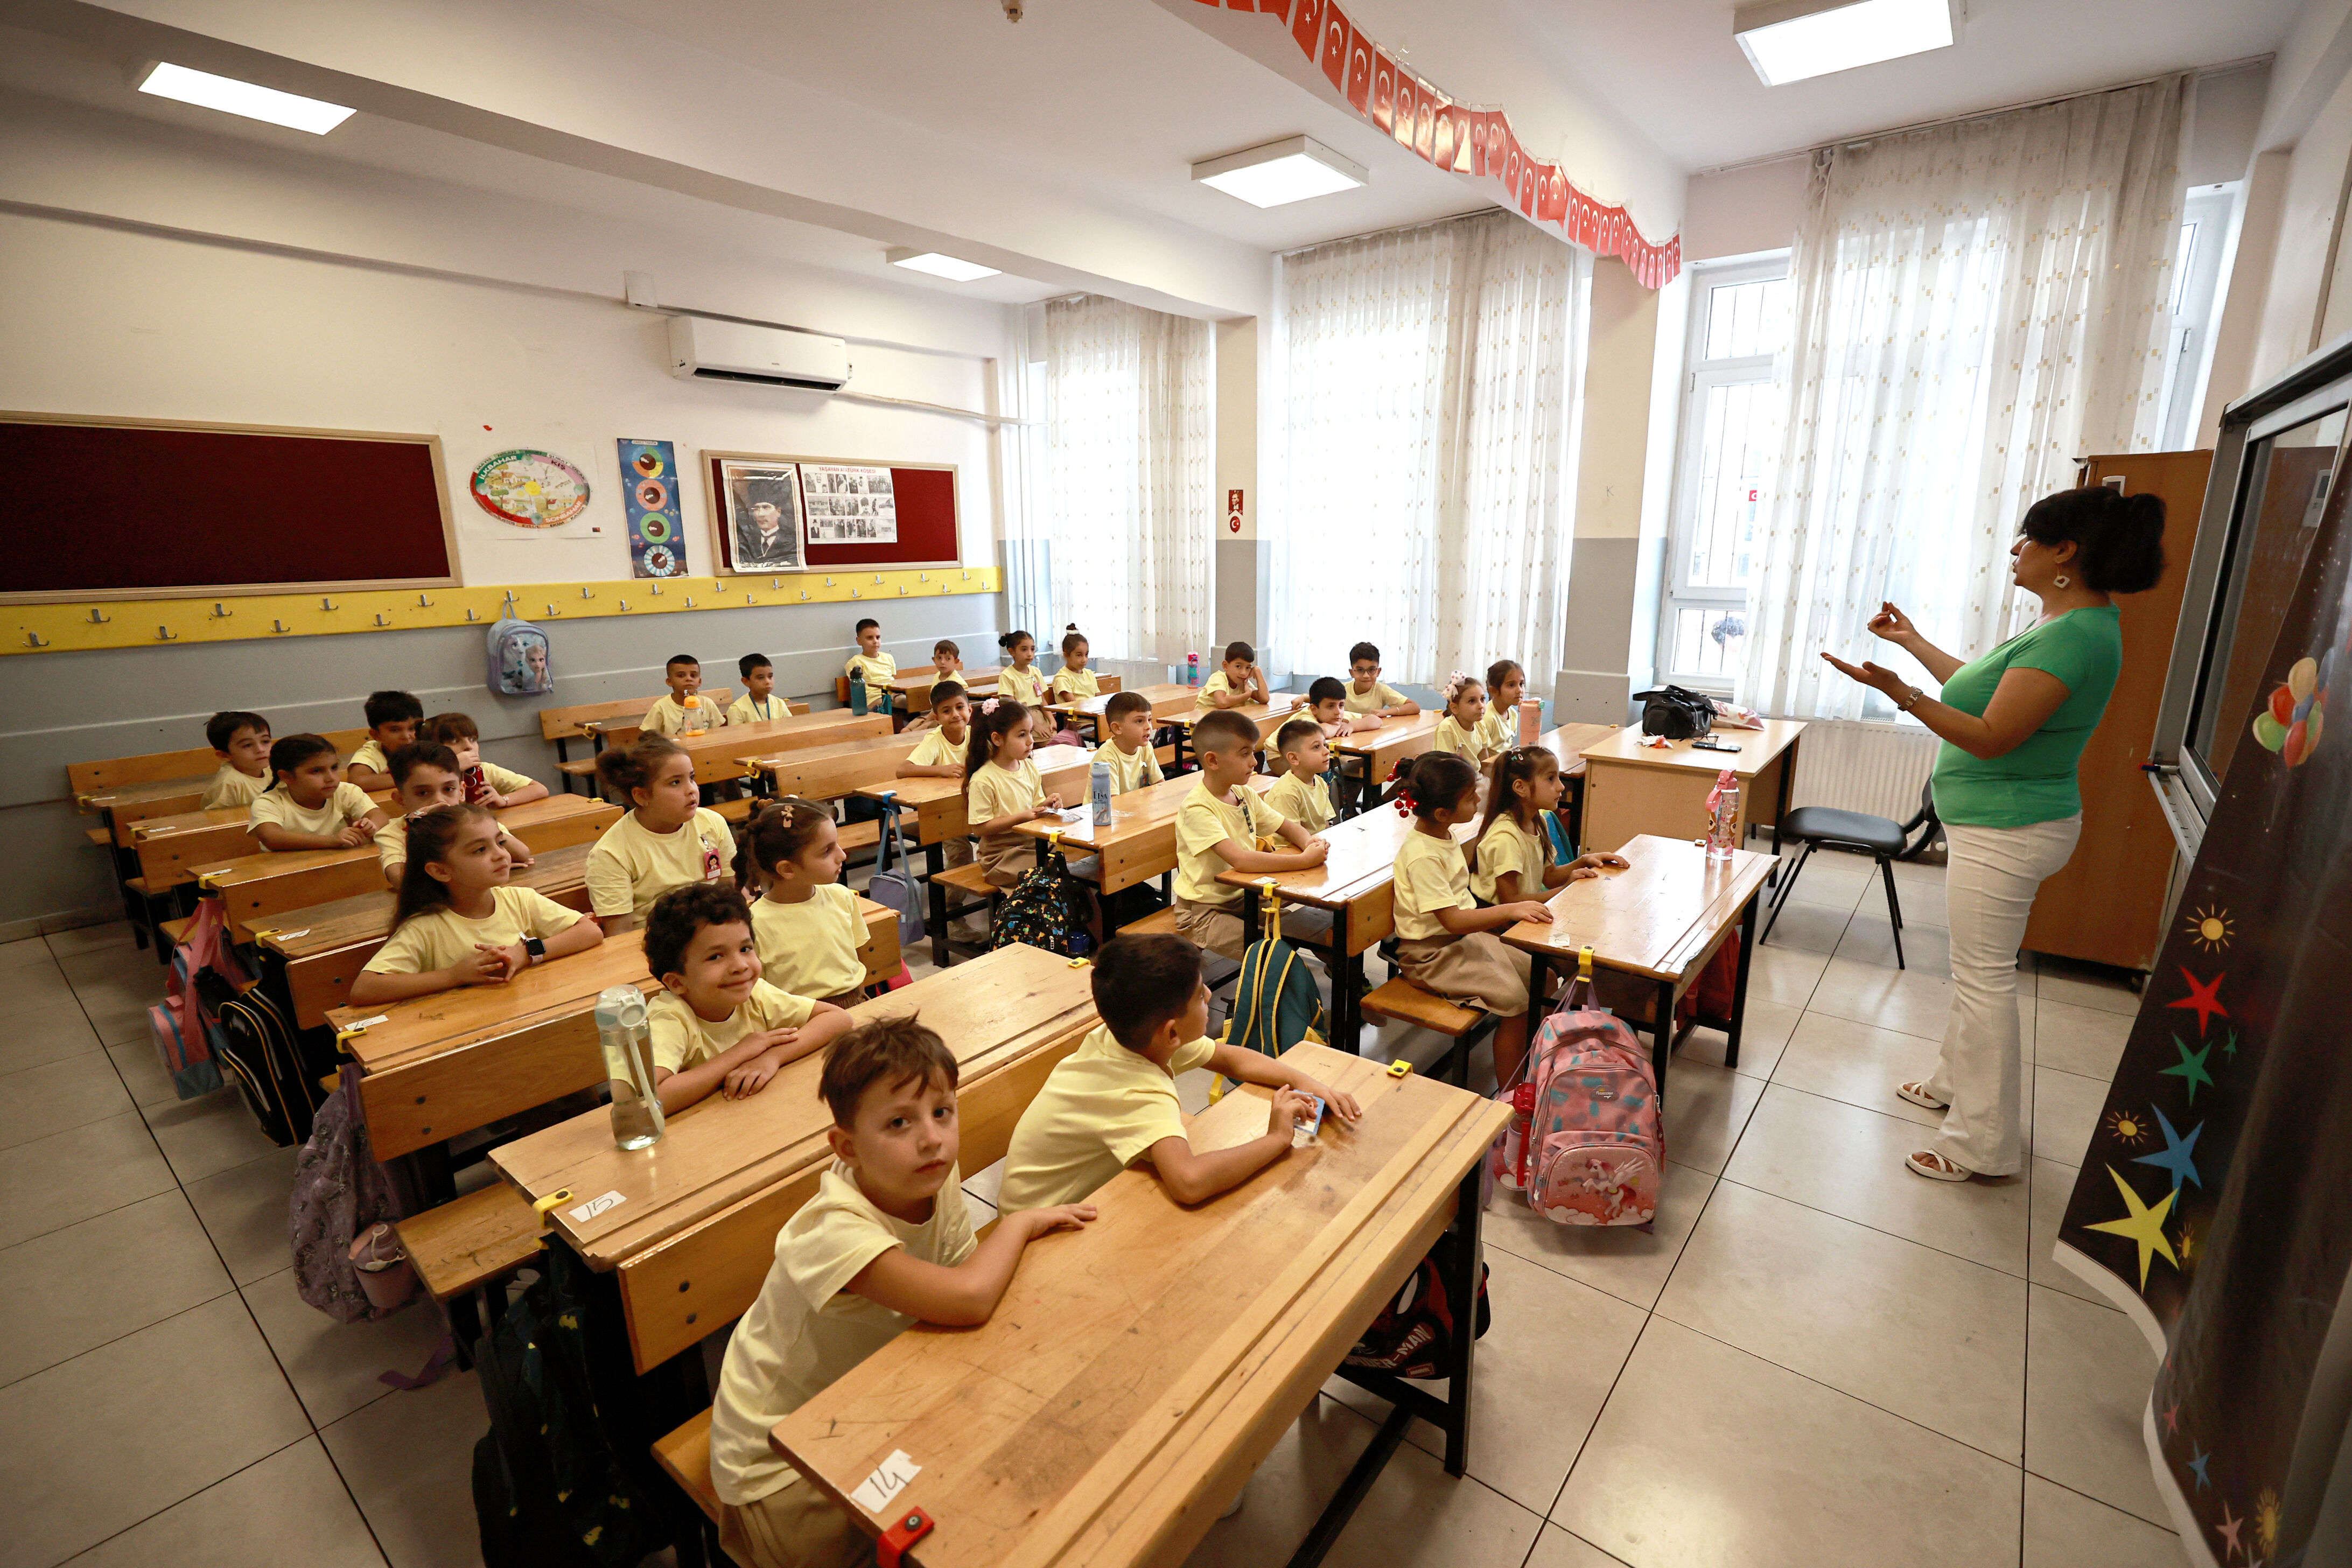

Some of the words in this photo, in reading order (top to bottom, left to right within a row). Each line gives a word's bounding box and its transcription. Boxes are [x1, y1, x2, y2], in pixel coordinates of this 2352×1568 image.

[354, 1018, 373, 1029] 16
[586, 1196, 613, 1219] 15
[870, 1467, 909, 1498] 14
